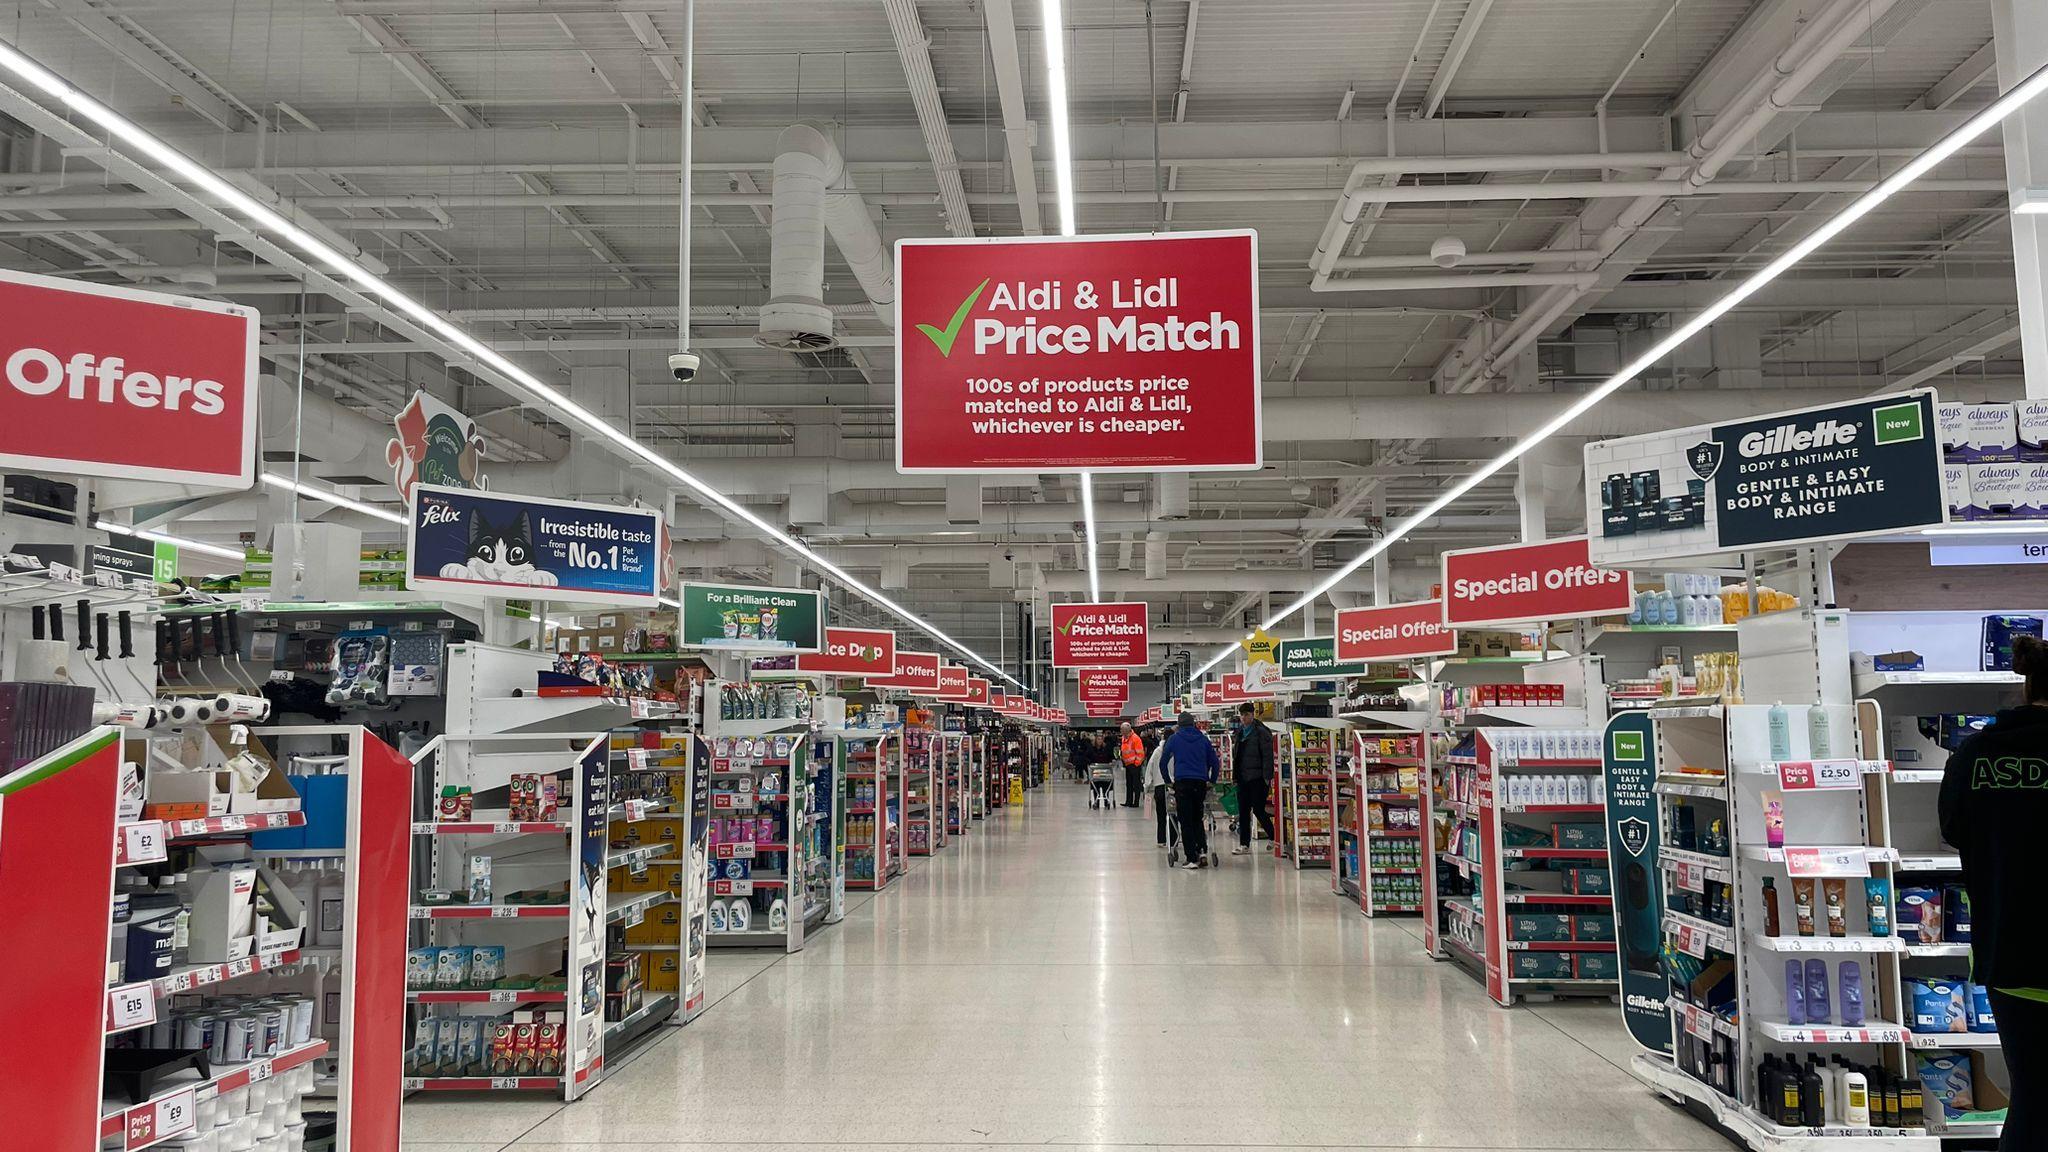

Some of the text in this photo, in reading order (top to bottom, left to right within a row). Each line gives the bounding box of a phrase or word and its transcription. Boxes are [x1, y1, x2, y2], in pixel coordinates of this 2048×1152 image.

[988, 277, 1178, 311] Aldi & Lidl
[973, 311, 1240, 355] Price Match
[4, 346, 226, 416] Offers
[966, 374, 1190, 397] 100s of products price
[964, 394, 1193, 415] matched to Aldi & Lidl,
[1967, 407, 2009, 423] always
[971, 415, 1185, 436] whichever is cheaper.
[1885, 417, 1911, 430] New
[1696, 451, 1712, 464] #1
[1739, 446, 1860, 474] BODY & INTIMATE
[1736, 465, 1873, 495] GENTLE & EASY
[1978, 466, 2020, 481] always
[1726, 479, 1885, 511] BODY & INTIMATE
[421, 504, 461, 528] felix
[1773, 500, 1837, 520] RANGE
[540, 517, 651, 543] Irresistible taste
[548, 539, 619, 571] from No.1
[553, 549, 566, 558] the
[622, 546, 634, 555] Pet
[112, 555, 133, 567] sprays
[622, 555, 639, 564] Food
[157, 559, 173, 578] 15
[1453, 565, 1621, 602] Special Offers
[706, 592, 724, 603] For
[733, 594, 770, 605] Brilliant
[771, 597, 797, 607] Clean
[1076, 614, 1127, 624] Aldi & Lidl
[1071, 623, 1143, 636] Price Match
[1341, 623, 1397, 644] Special
[825, 641, 846, 657] ice
[1250, 641, 1271, 649] ASDA
[1287, 648, 1313, 660] ASDA
[1286, 659, 1318, 669] Pounds,
[1318, 659, 1333, 667] not
[906, 666, 936, 678] Offers
[940, 677, 965, 687] Offers
[1227, 682, 1240, 691] Mix
[1206, 690, 1222, 698] Spec
[1620, 742, 1637, 750] New
[1611, 767, 1640, 776] GENTLE
[1784, 767, 1808, 776] Price
[1820, 768, 1851, 778] £2.50
[1971, 756, 2048, 790] ASD
[1620, 775, 1640, 784] EASY
[1616, 783, 1638, 791] BODY
[1613, 791, 1650, 799] INTIMATE
[1618, 799, 1646, 807] RANGE
[1627, 829, 1641, 839] #1
[141, 835, 152, 847] £2
[1836, 856, 1850, 865] £3
[126, 999, 142, 1013] £15
[1626, 994, 1665, 1012] Gillette
[1924, 999, 1945, 1007] Pants
[170, 1105, 182, 1121] £9
[130, 1112, 152, 1129] Price
